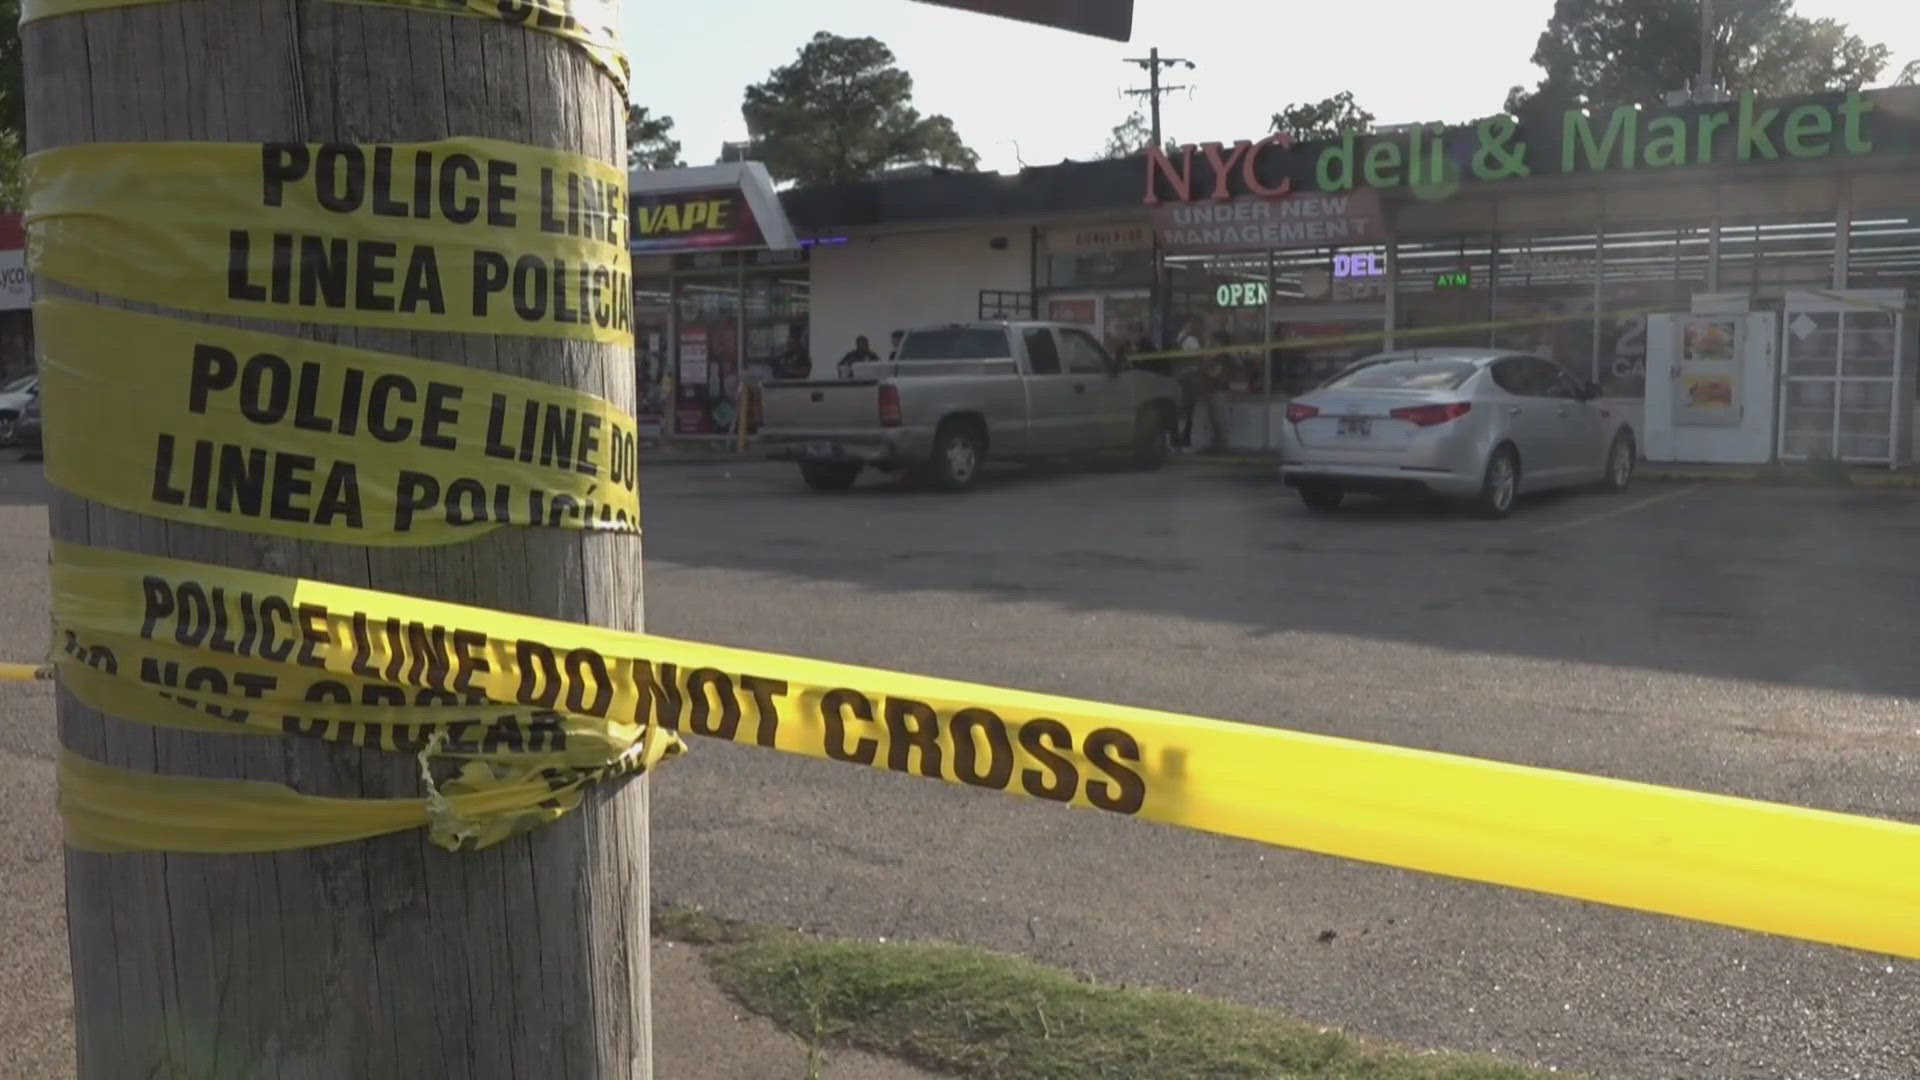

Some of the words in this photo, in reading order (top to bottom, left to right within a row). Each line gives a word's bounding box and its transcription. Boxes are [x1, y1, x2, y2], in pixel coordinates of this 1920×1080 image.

[1144, 133, 1291, 204] NYC
[1316, 122, 1444, 192] deli
[1472, 113, 1530, 180] &
[1561, 88, 1874, 175] Market
[262, 142, 517, 228] POLICE
[540, 168, 620, 245] LINE
[638, 202, 729, 234] VAPE
[1173, 201, 1271, 226] UNDER
[1281, 198, 1349, 218] NEW
[1164, 217, 1370, 246] MANAGEMENT
[0, 268, 25, 288] yco
[228, 230, 446, 314] LINEA
[1217, 281, 1268, 307] OPEN
[1437, 273, 1468, 287] ATM
[189, 344, 463, 449] POLICE
[486, 393, 601, 477] LINE
[610, 417, 636, 493] DO
[153, 434, 365, 528] LINEA
[140, 576, 330, 668] POLICE
[351, 612, 490, 692] LINE
[515, 638, 612, 716] DO
[633, 657, 787, 748] NOT
[820, 687, 1147, 814] CROSS
